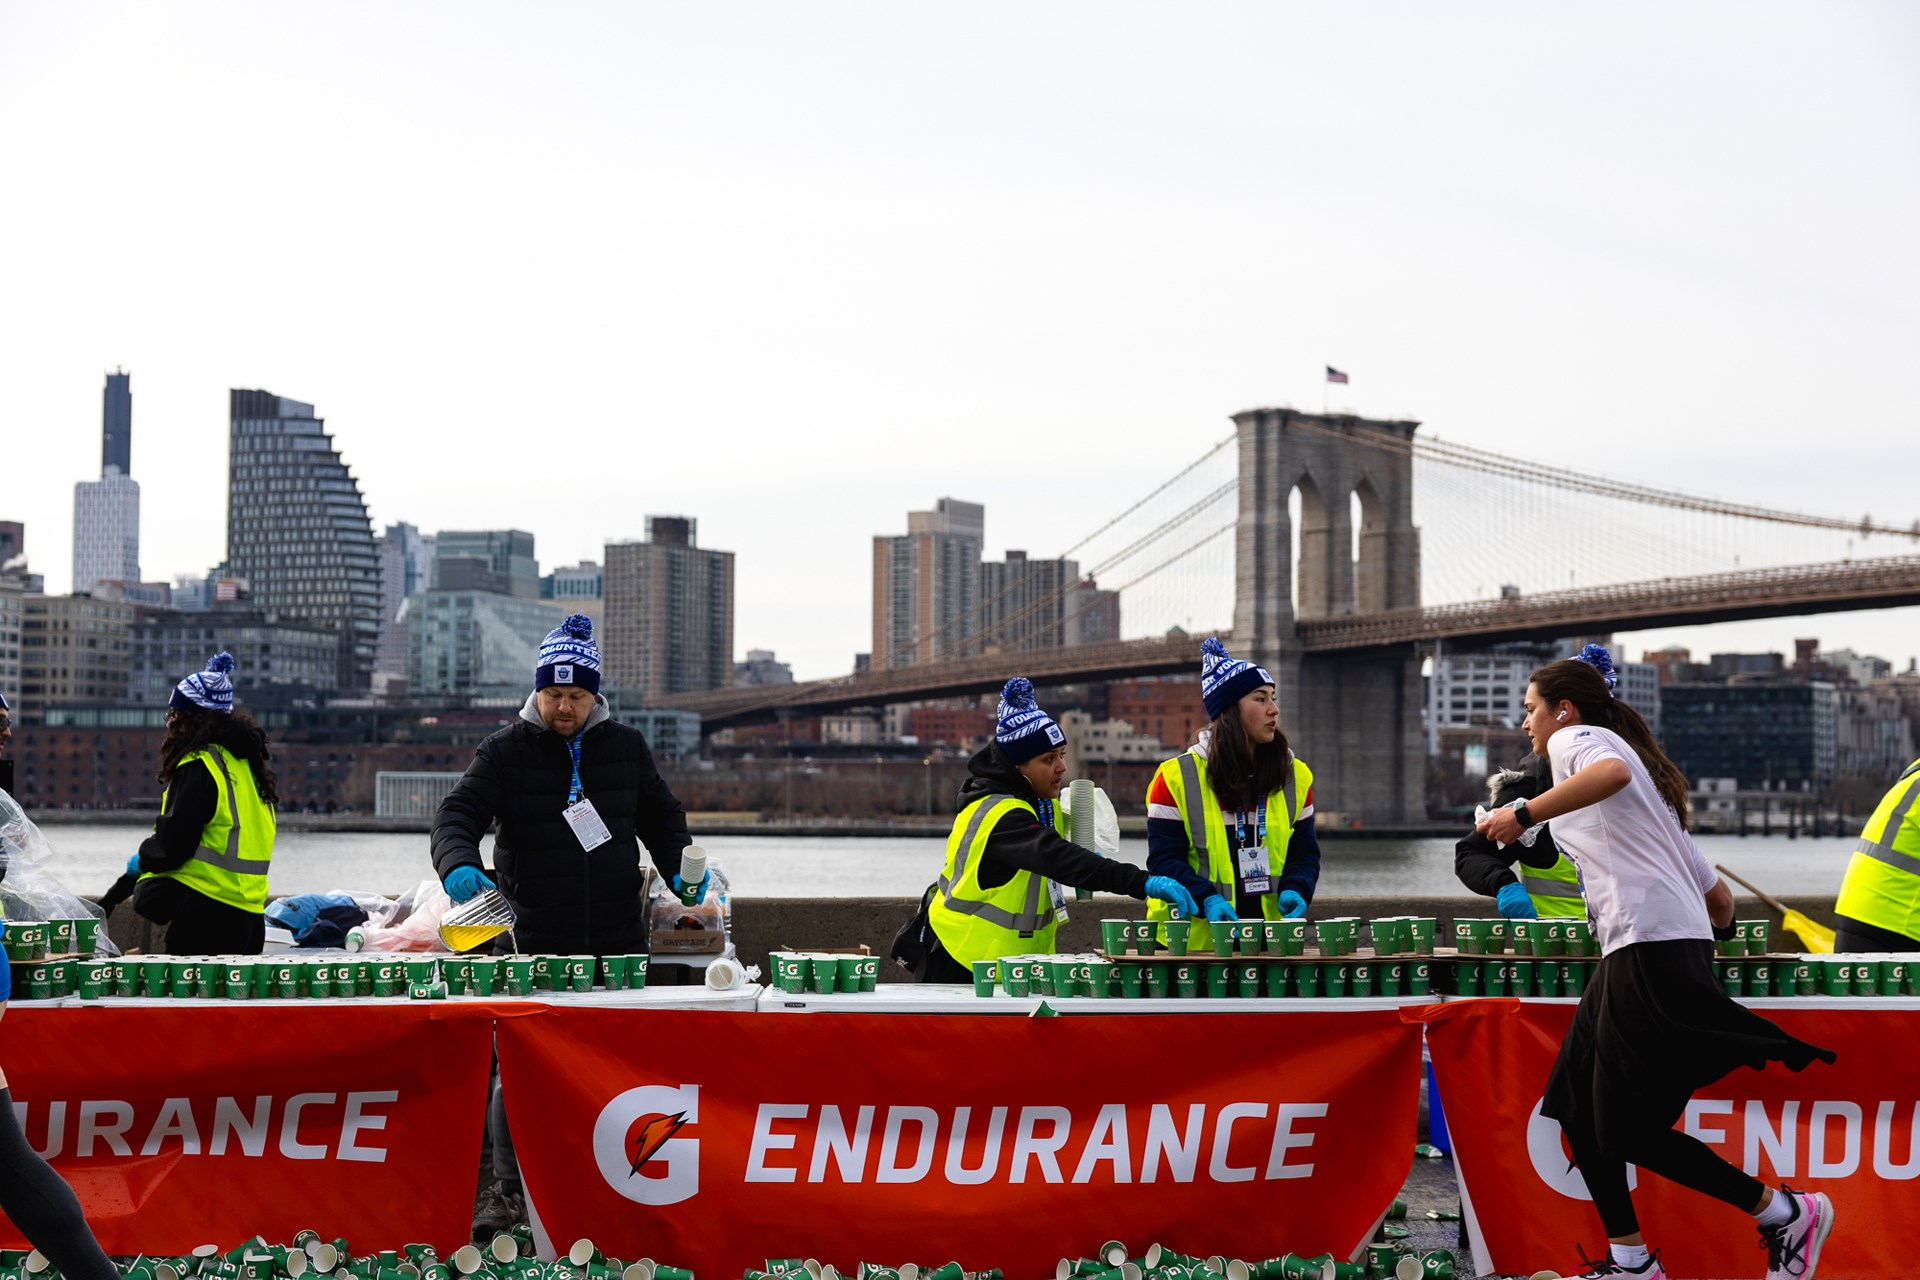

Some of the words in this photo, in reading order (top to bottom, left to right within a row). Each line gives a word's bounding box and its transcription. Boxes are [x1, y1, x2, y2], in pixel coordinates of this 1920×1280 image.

[687, 886, 697, 894] G
[58, 924, 69, 936] G
[1138, 926, 1148, 937] G
[1242, 926, 1253, 938] G
[1293, 926, 1304, 938] G
[1492, 924, 1503, 935] G
[1515, 925, 1525, 937] G
[1566, 927, 1576, 938] G
[1752, 926, 1764, 937] G
[22, 930, 33, 942] G
[53, 967, 63, 979] G
[102, 966, 112, 979] G
[379, 967, 391, 979] G
[537, 961, 547, 973] G
[574, 963, 583, 975] G
[787, 963, 798, 975] G
[864, 962, 875, 974] G
[986, 967, 995, 978] G
[1012, 967, 1023, 978] G
[1356, 967, 1367, 978] G
[1417, 965, 1428, 977] G
[1727, 967, 1738, 979] G
[1756, 967, 1768, 979] G
[1798, 966, 1808, 978] G
[1839, 967, 1849, 978] G
[1857, 967, 1868, 978] G
[1893, 966, 1902, 978] G
[34, 969, 45, 981] G
[91, 969, 102, 981] G
[183, 968, 193, 980] G
[230, 969, 240, 981] G
[280, 969, 290, 980] G
[316, 968, 328, 980] G
[338, 968, 348, 979] G
[1178, 968, 1188, 979] G
[1245, 968, 1256, 979] G
[592, 1083, 701, 1207] G
[744, 1102, 1330, 1186] ENDURANCE
